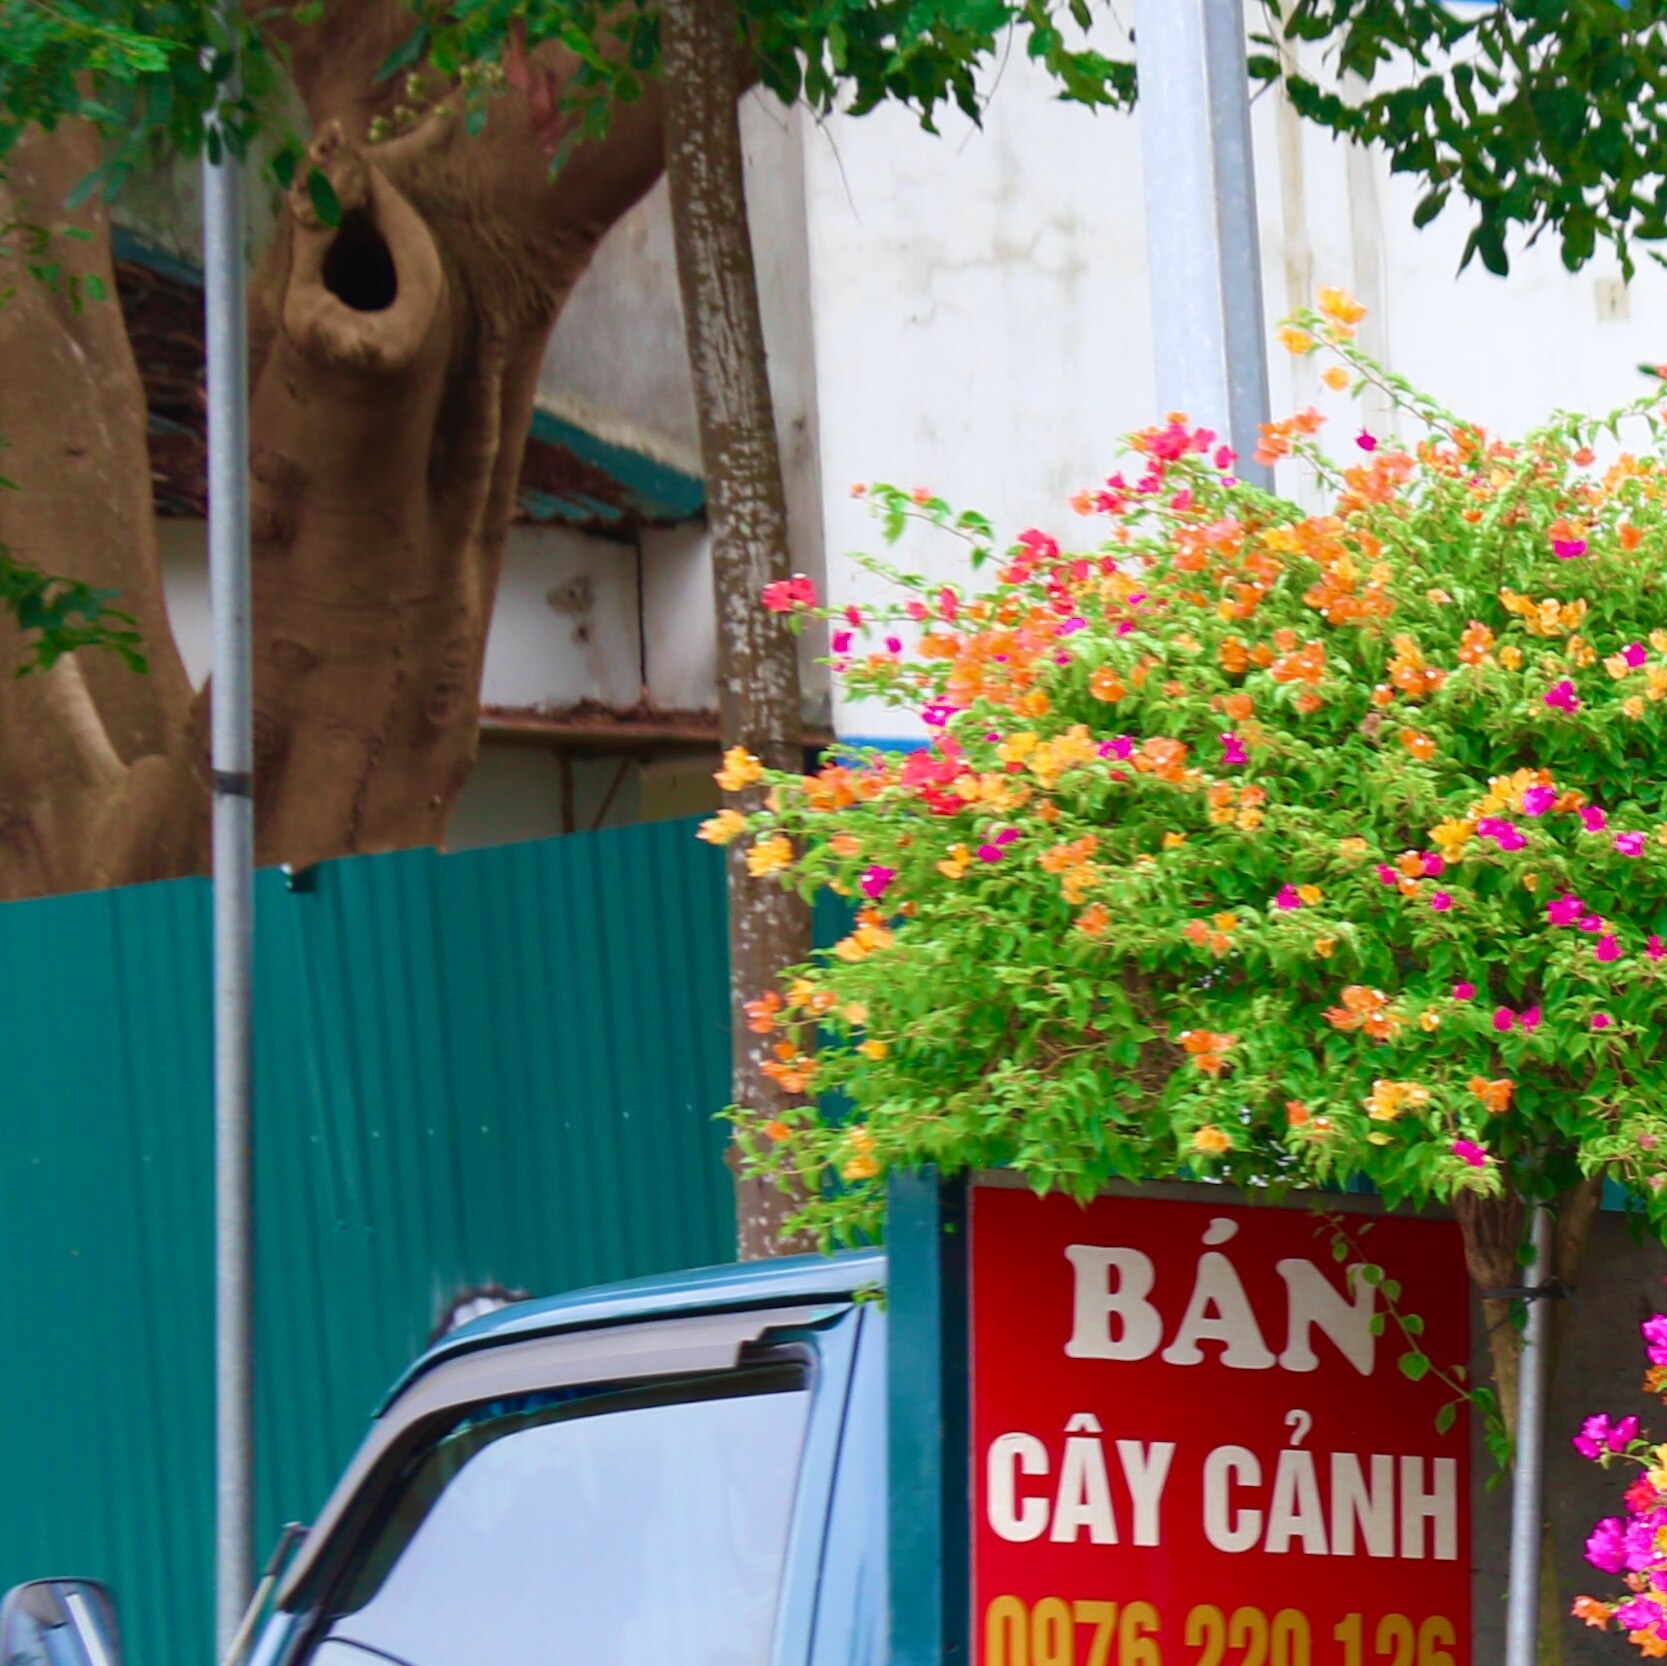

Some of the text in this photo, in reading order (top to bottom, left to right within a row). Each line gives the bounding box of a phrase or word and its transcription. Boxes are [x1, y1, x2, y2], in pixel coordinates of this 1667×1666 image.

[1063, 1217, 1385, 1377] BÁN
[986, 1408, 1459, 1561] CÂY CẢNH
